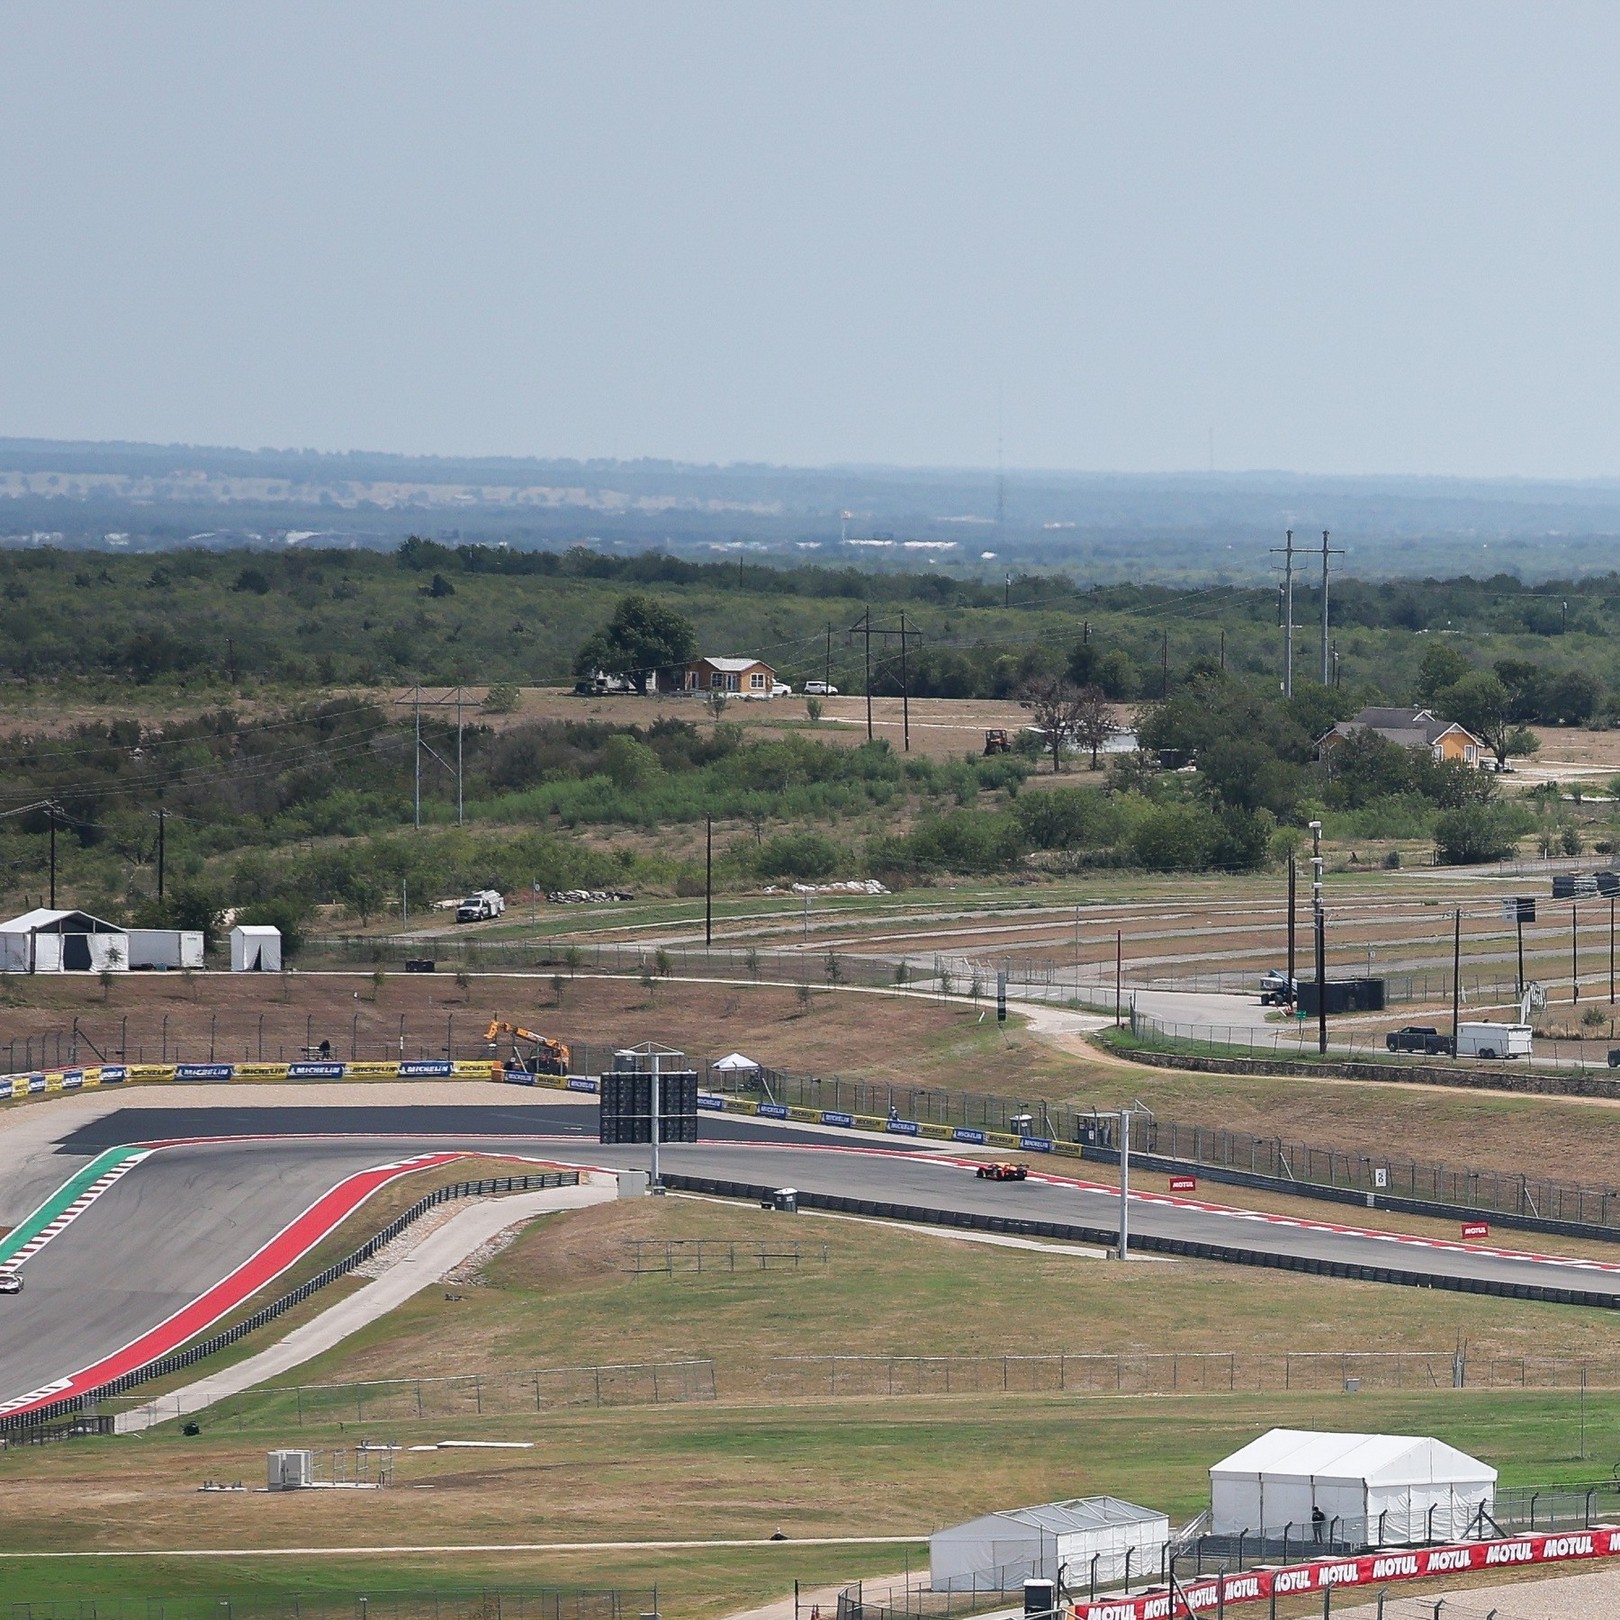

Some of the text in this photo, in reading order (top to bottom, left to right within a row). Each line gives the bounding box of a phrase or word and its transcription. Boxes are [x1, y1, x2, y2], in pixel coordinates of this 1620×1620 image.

[184, 1067, 229, 1077] MICHELIN
[296, 1065, 341, 1075] MICHELIN
[352, 1066, 397, 1074] MICHELIN
[407, 1063, 449, 1073] MICHELIN
[1224, 1578, 1260, 1601] MOTUL
[1318, 1564, 1359, 1585] MOTUL
[1372, 1556, 1418, 1579] MOTUL
[1427, 1550, 1472, 1571] MOTUL
[1486, 1543, 1533, 1564] MOTUL
[1542, 1536, 1594, 1558] MOTUL
